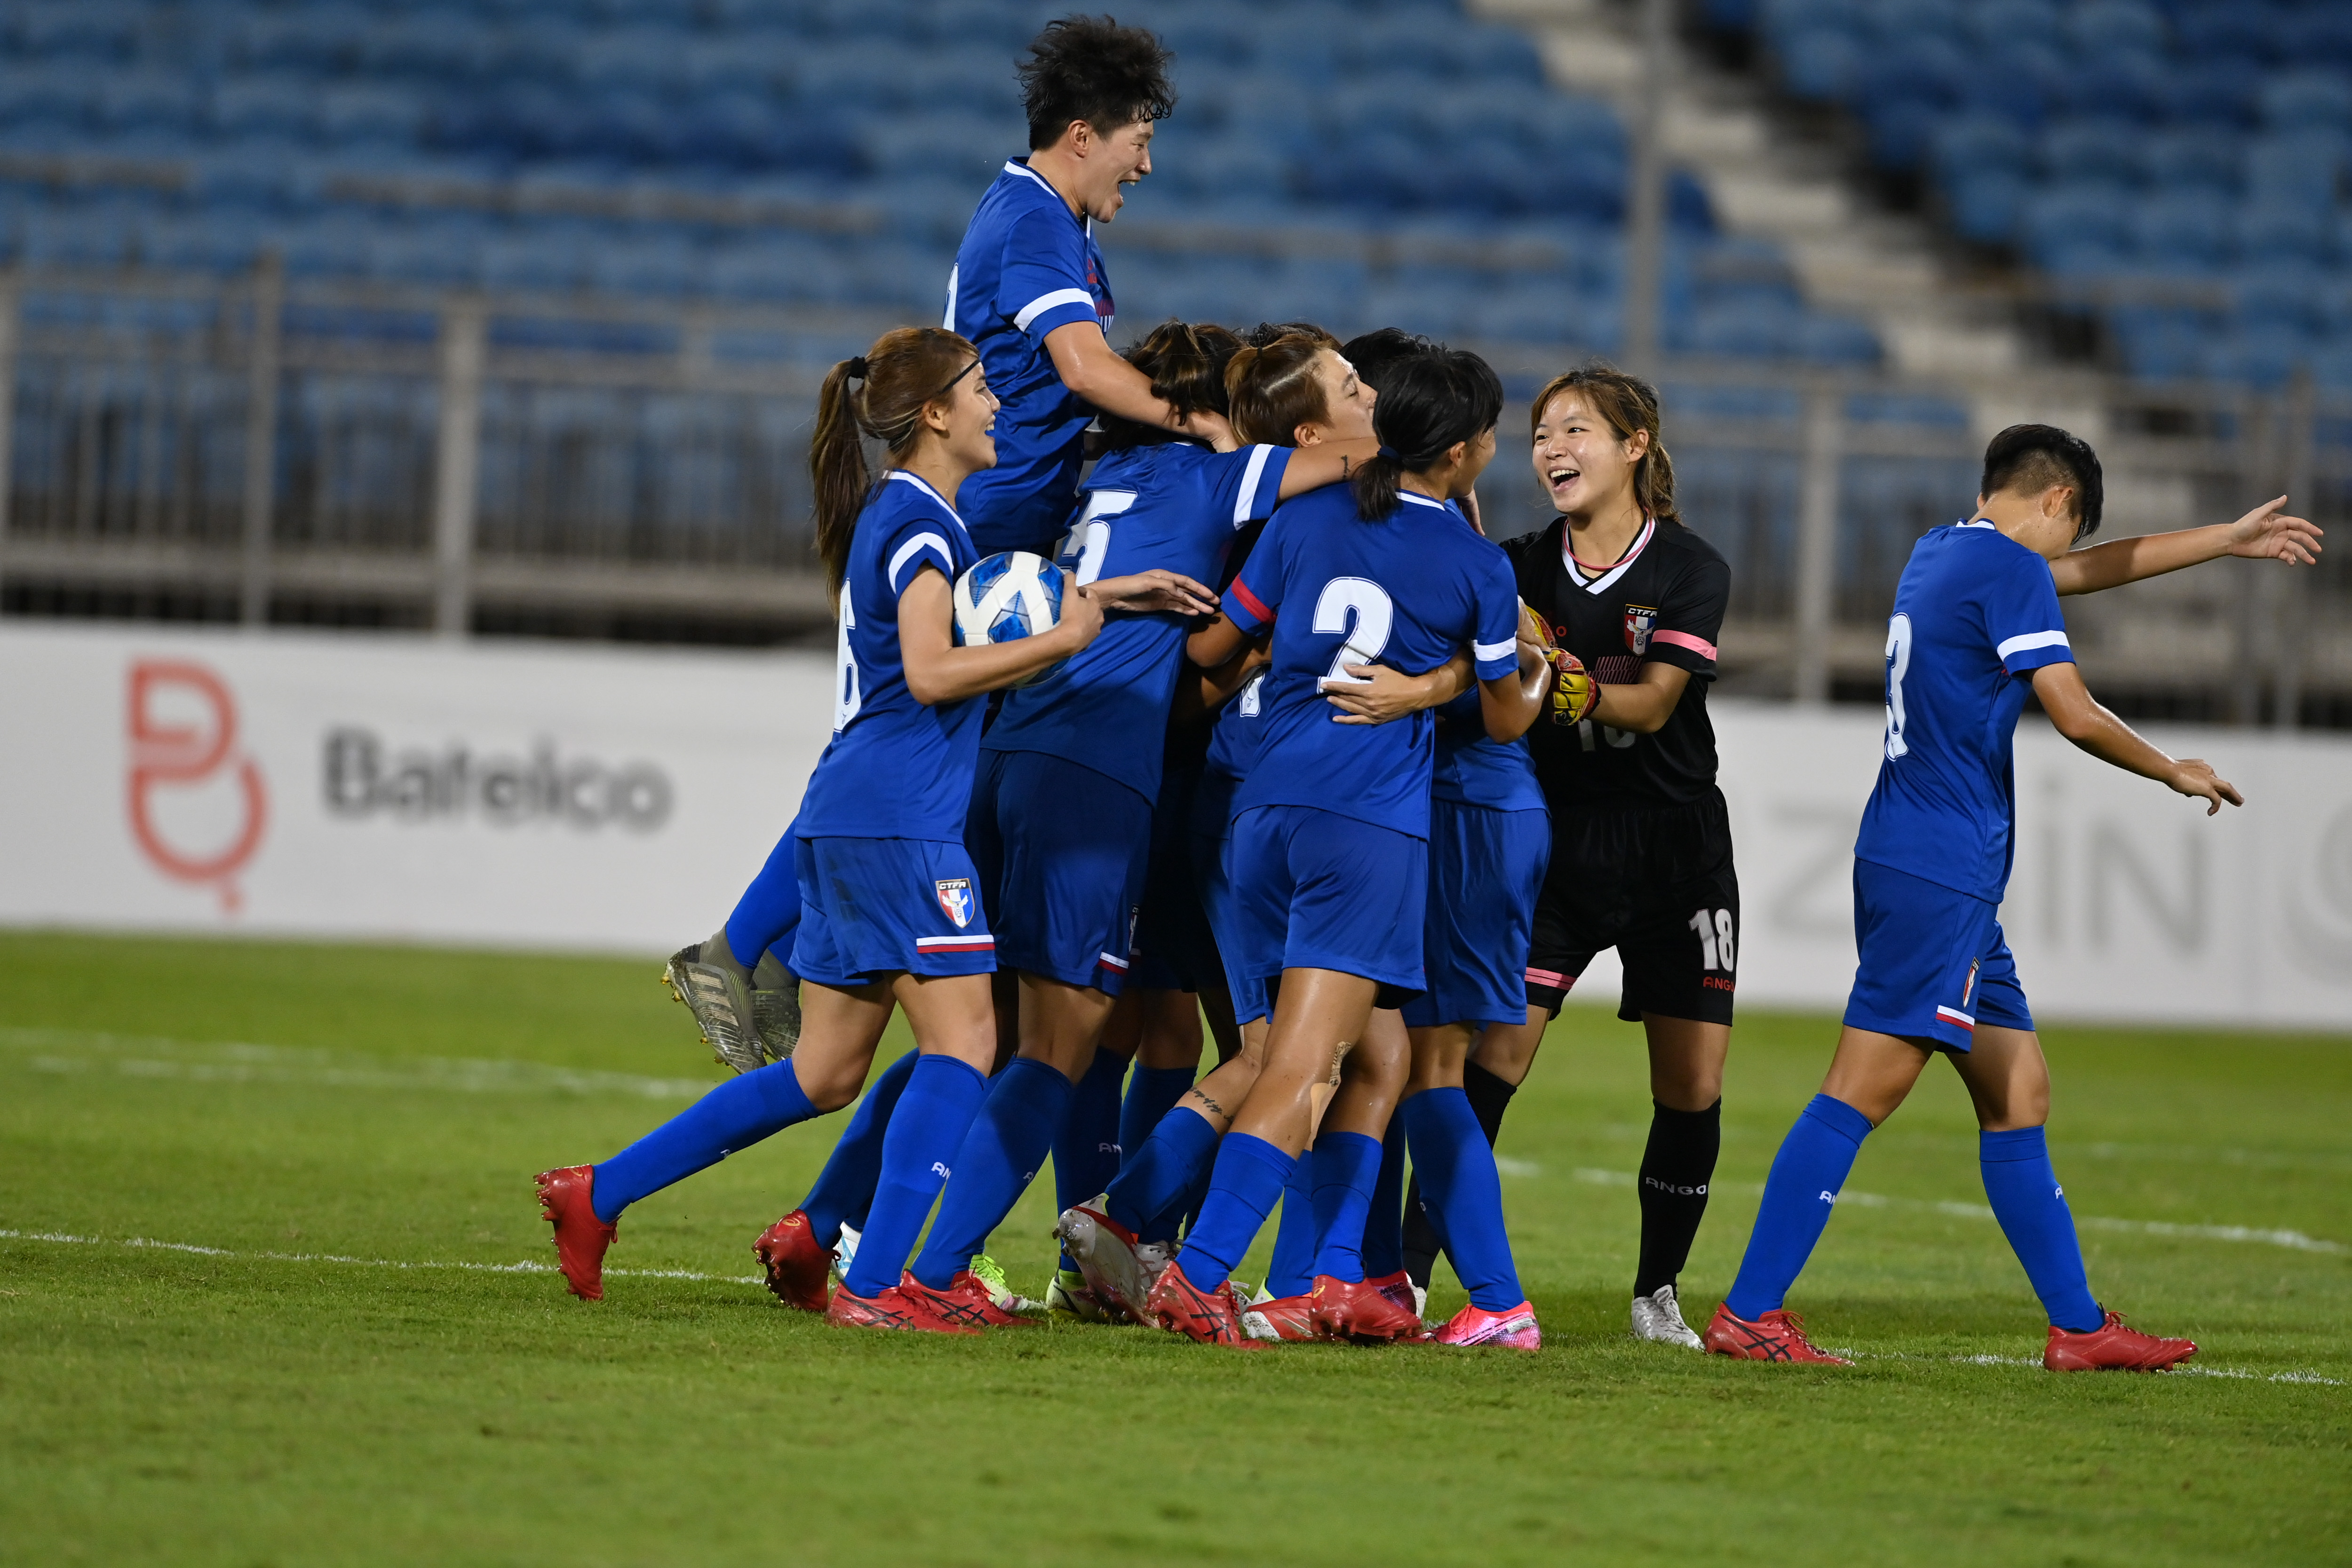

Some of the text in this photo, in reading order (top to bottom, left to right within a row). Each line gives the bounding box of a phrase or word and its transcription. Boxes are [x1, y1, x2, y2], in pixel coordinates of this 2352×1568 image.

[1628, 608, 1657, 617] CTFA
[1312, 576, 1393, 695] 2
[939, 881, 966, 890] CTFA
[1688, 908, 1733, 972] 18
[1703, 976, 1735, 992] ANGO
[931, 1162, 952, 1180] AN
[1645, 1177, 1707, 1195] ANGO
